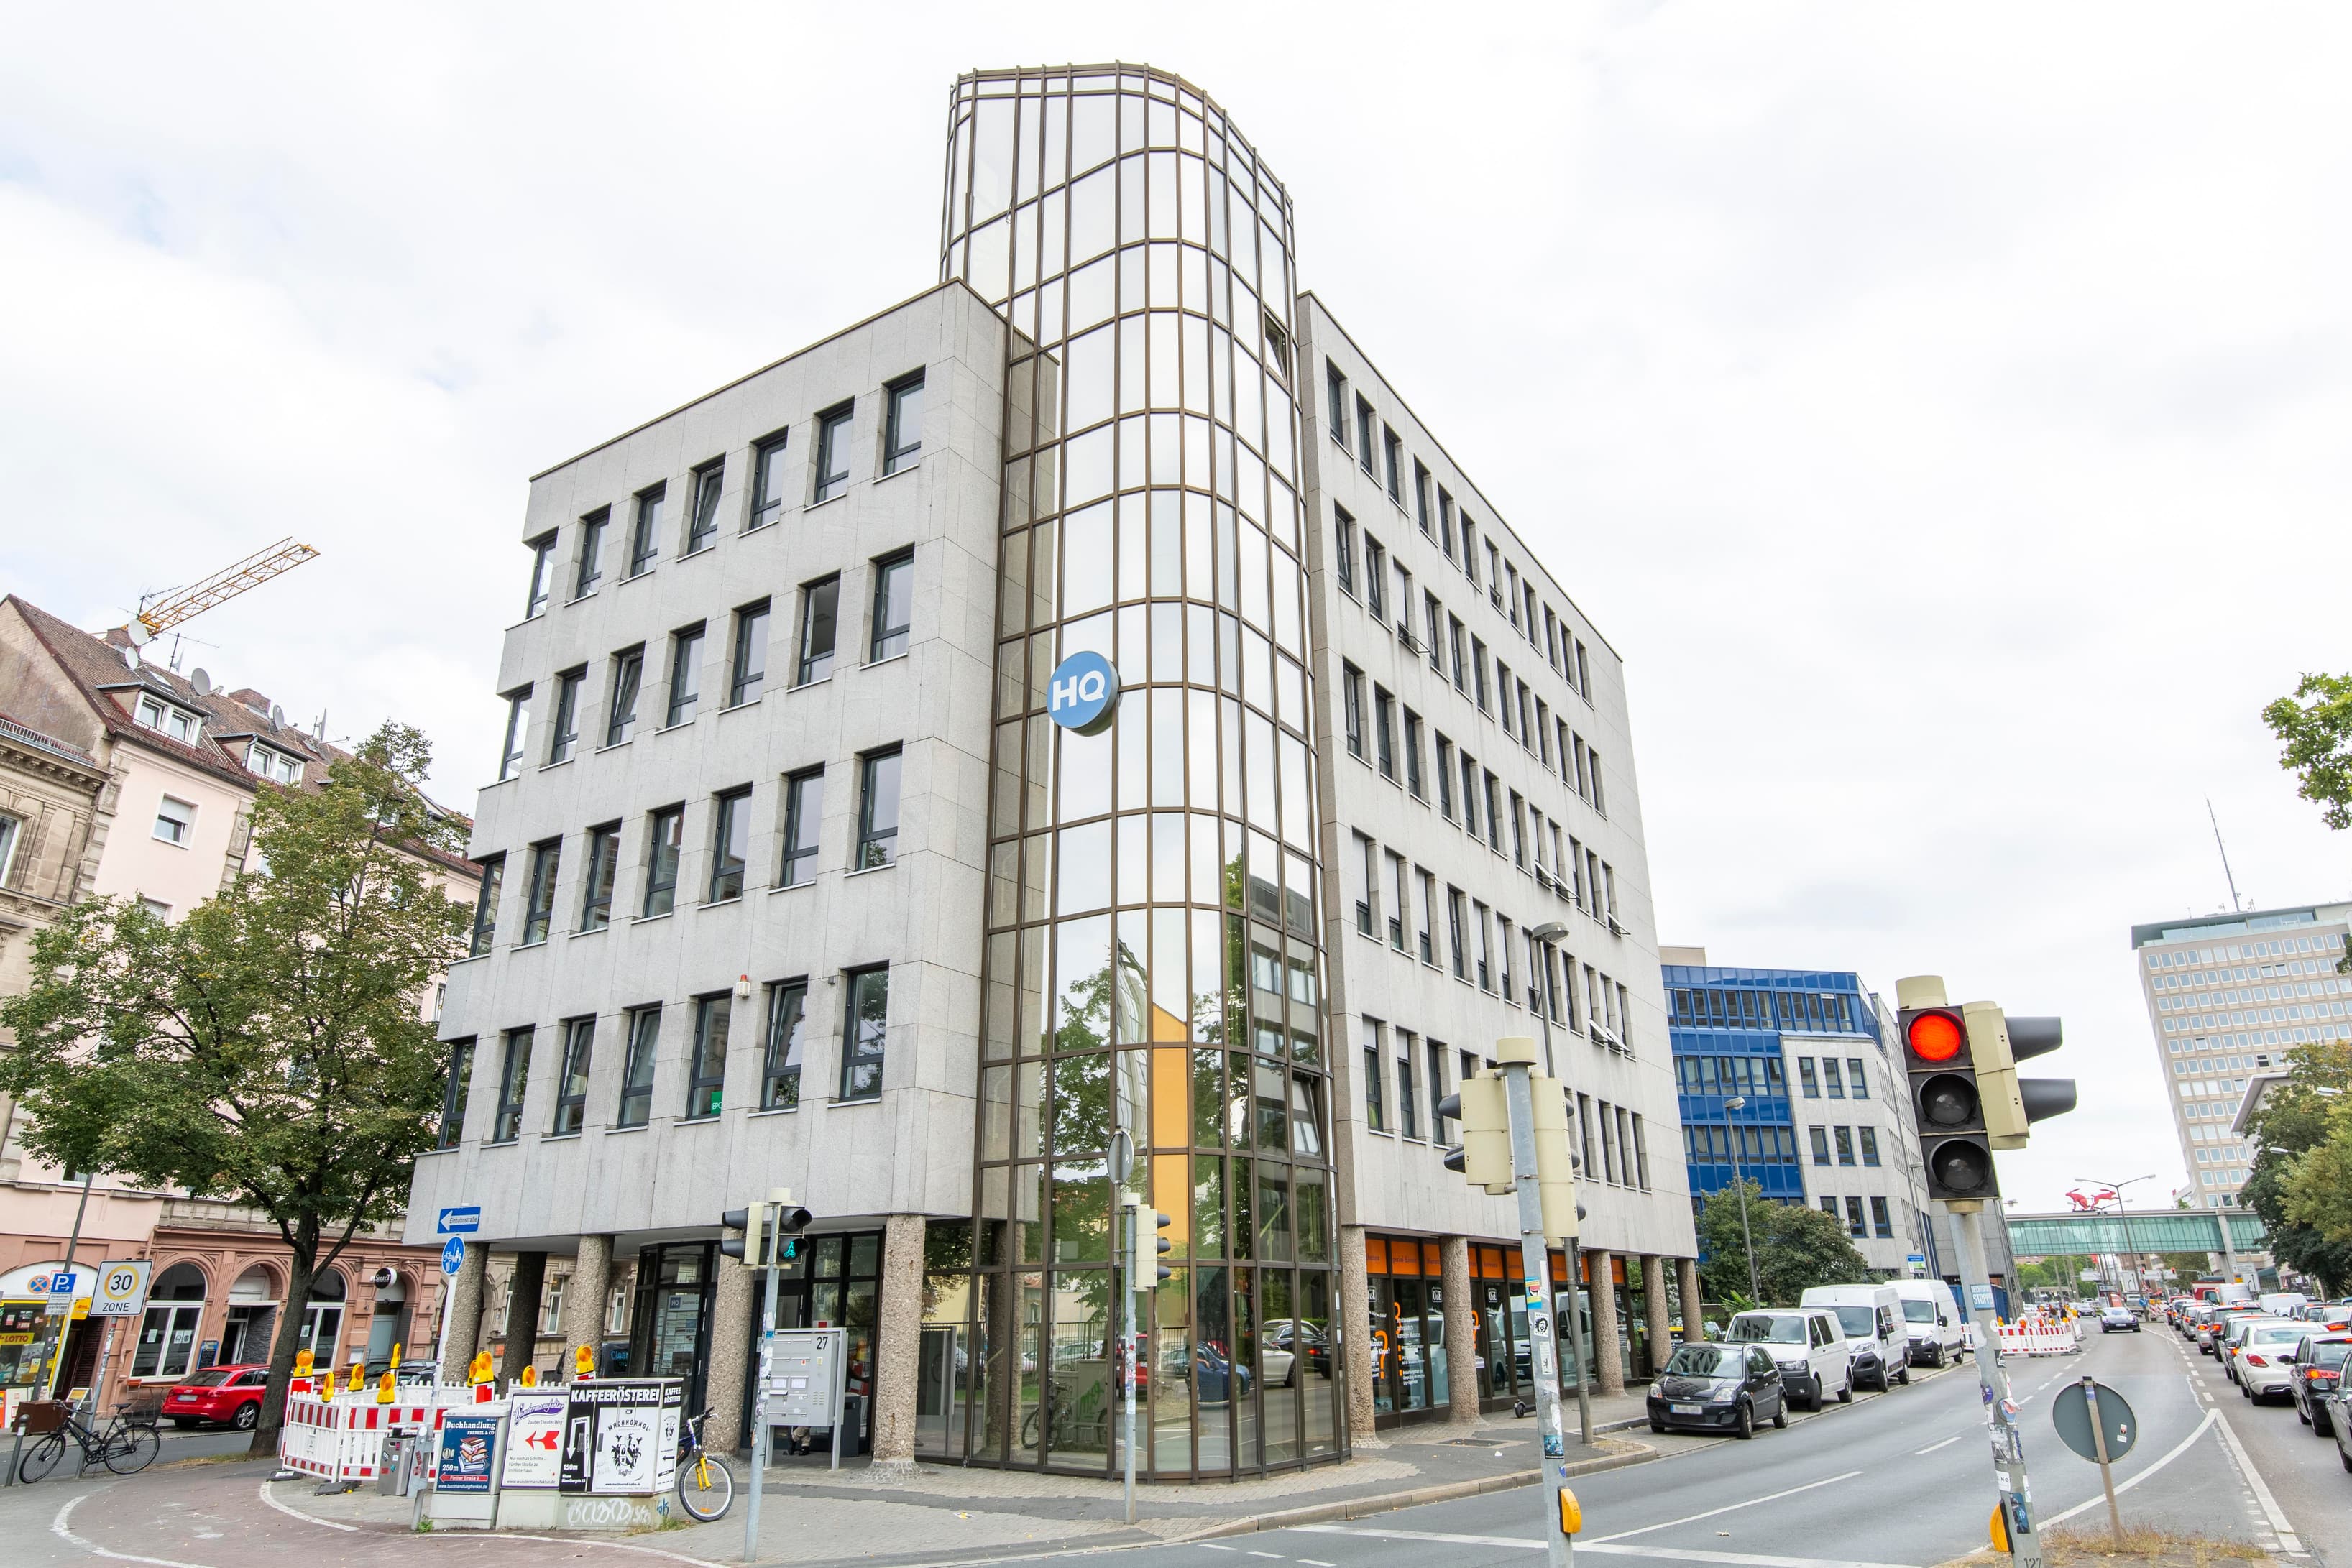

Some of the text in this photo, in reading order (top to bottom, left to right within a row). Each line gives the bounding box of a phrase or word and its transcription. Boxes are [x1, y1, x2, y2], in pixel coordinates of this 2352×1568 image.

[1052, 670, 1105, 711] HQ
[55, 1276, 69, 1291] P
[111, 1275, 132, 1291] 30
[102, 1303, 130, 1311] ZONE
[817, 1337, 828, 1350] 27
[571, 1386, 660, 1402] KAFFEERÖSTEREI
[665, 1387, 681, 1396] KAFFEE
[446, 1421, 496, 1430] Buchhandlung
